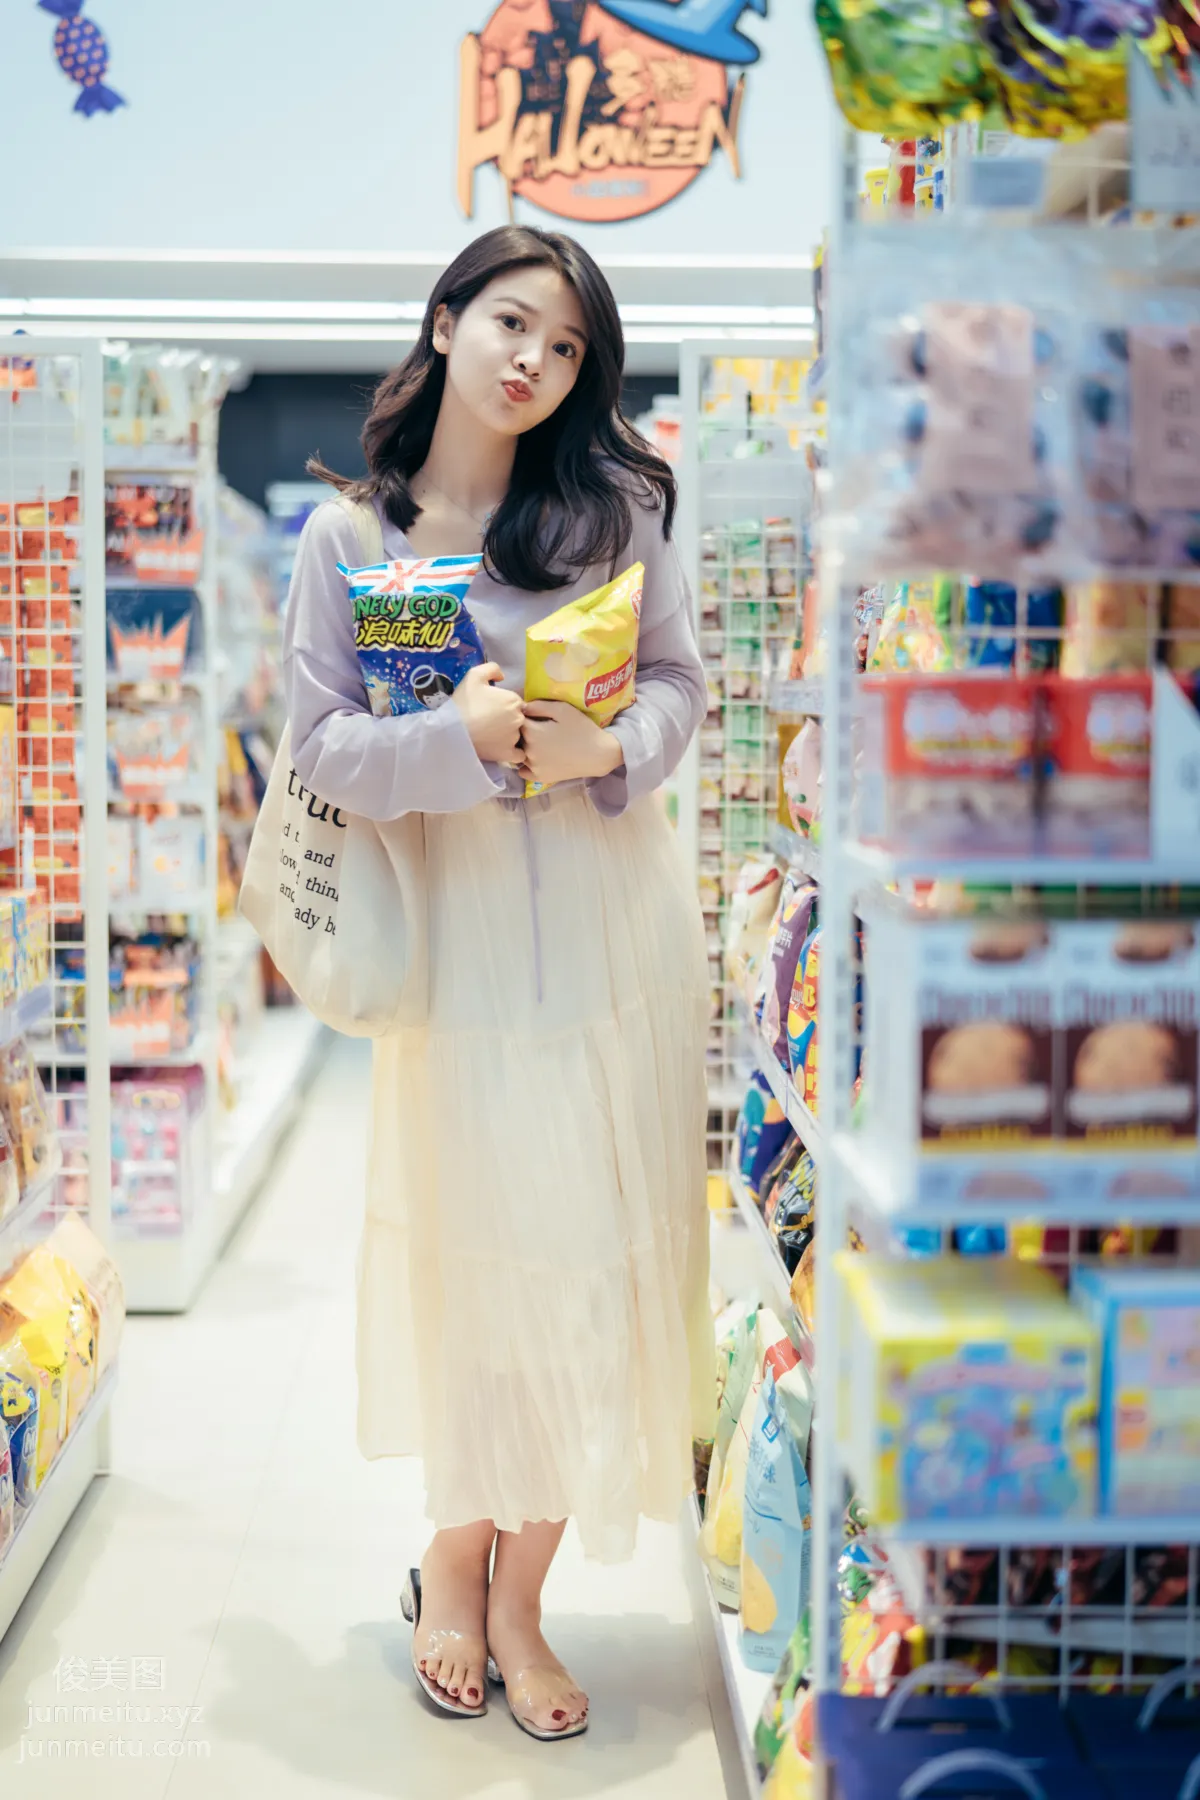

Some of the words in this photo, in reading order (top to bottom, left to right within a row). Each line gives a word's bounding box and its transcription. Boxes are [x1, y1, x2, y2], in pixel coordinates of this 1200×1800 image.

[353, 593, 404, 620] NELY
[407, 593, 458, 618] GOD
[356, 619, 452, 647] 浪味仙
[304, 849, 335, 868] and
[305, 876, 339, 902] thin
